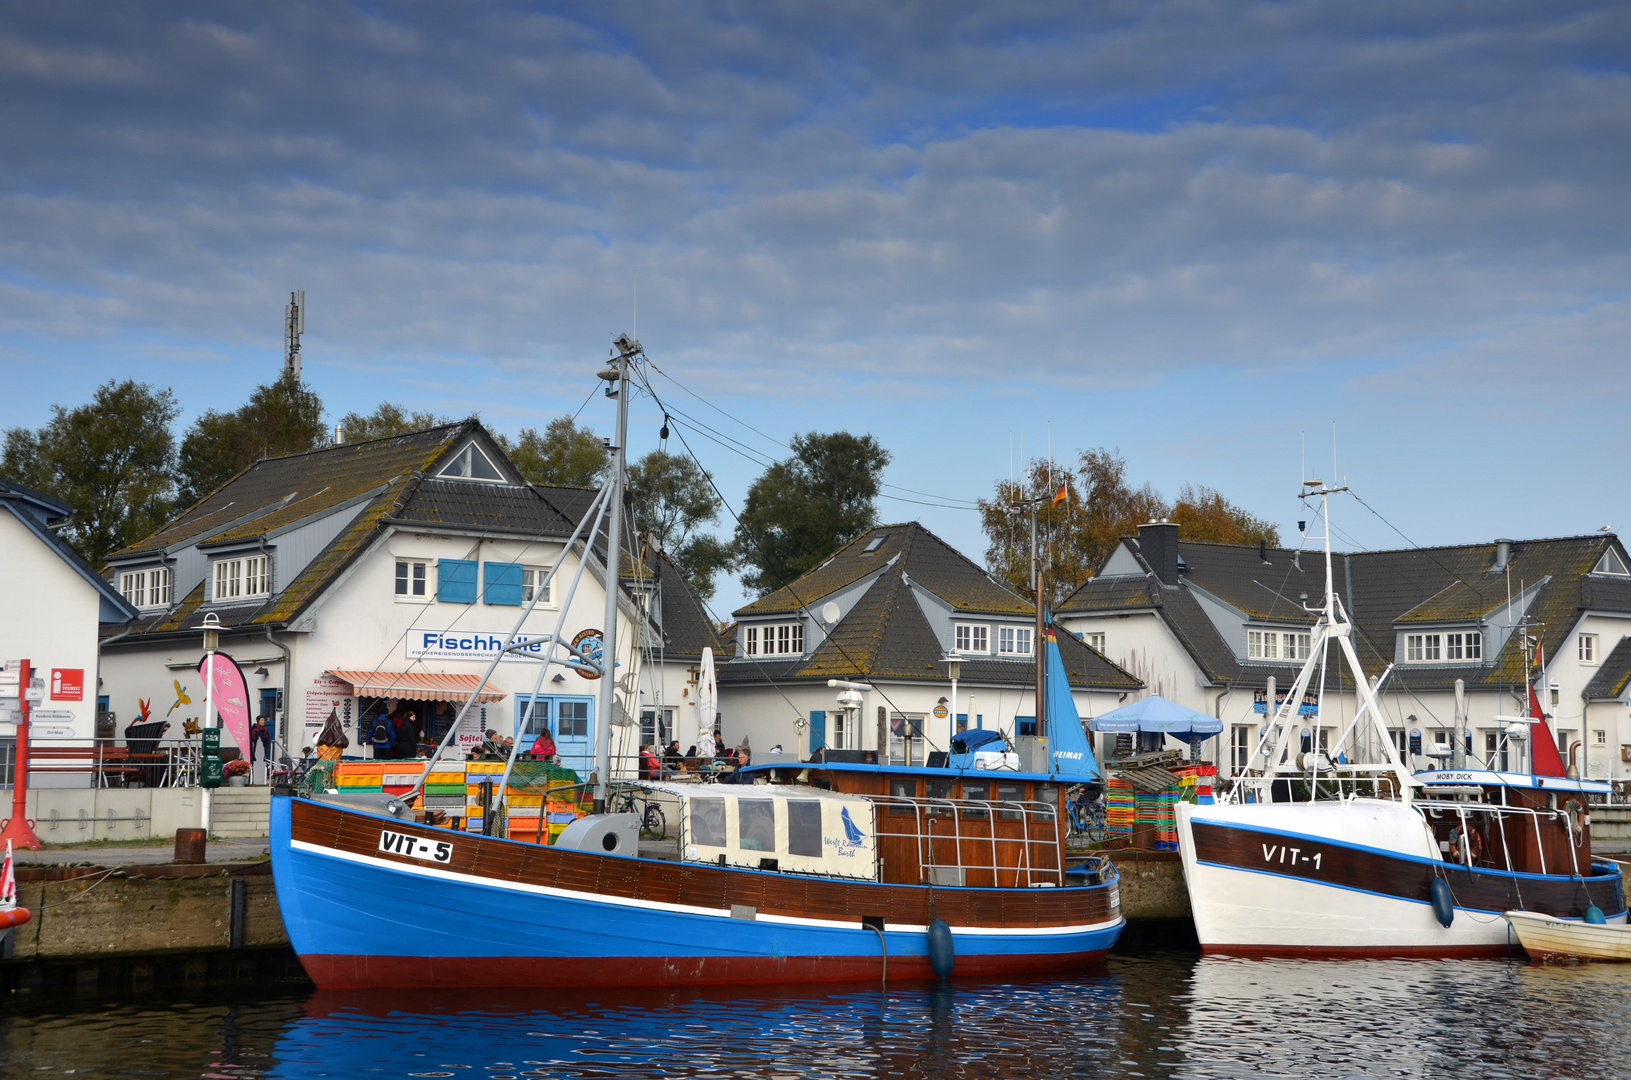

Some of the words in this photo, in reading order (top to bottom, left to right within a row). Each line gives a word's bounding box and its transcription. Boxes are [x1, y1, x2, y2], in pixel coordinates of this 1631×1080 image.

[423, 633, 541, 652] Fischhlle
[411, 650, 497, 658] FISCHEREIGENOSSENSCHAF
[1053, 750, 1083, 760] HEIMAT
[824, 837, 840, 848] Werft
[838, 847, 856, 857] Barth
[1262, 843, 1322, 870] VIT-1
